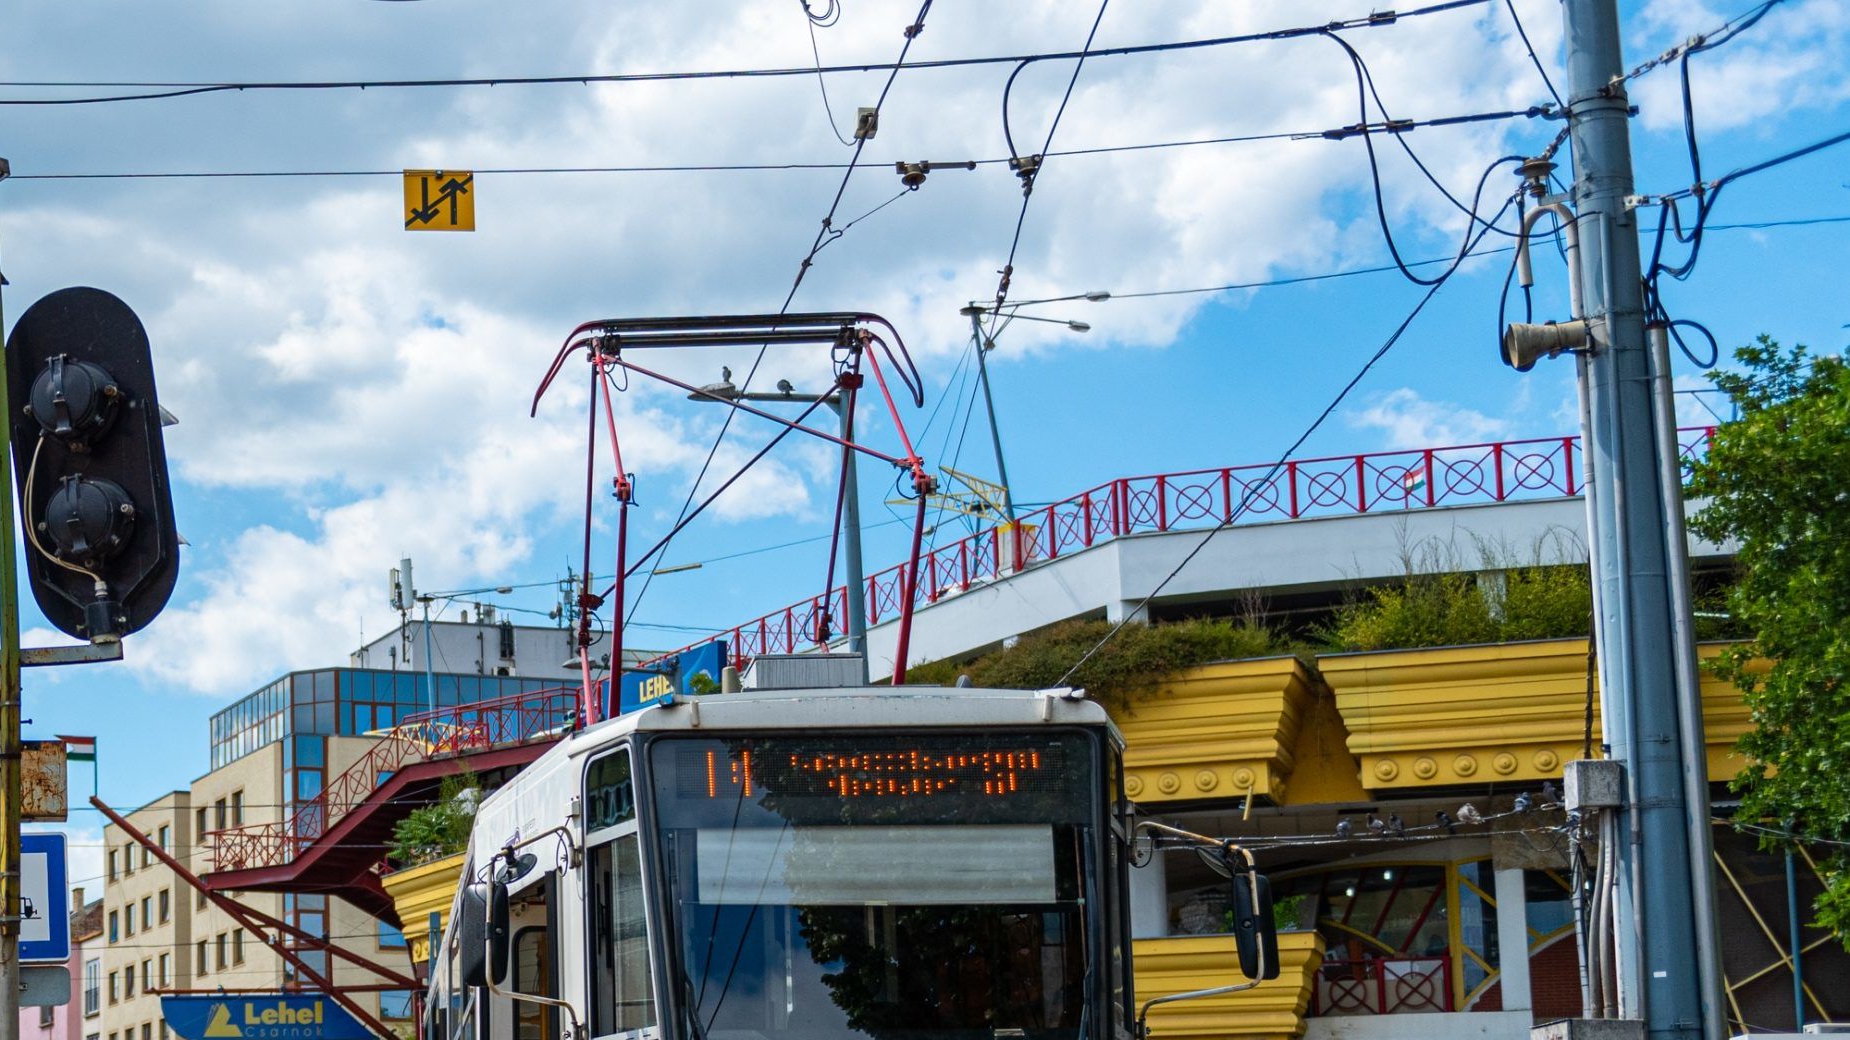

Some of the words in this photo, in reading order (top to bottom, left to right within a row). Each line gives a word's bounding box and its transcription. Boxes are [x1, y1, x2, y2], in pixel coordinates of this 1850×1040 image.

[639, 674, 672, 703] LEHE
[244, 1001, 323, 1025] Lehel
[245, 1026, 323, 1038] Csarnok
